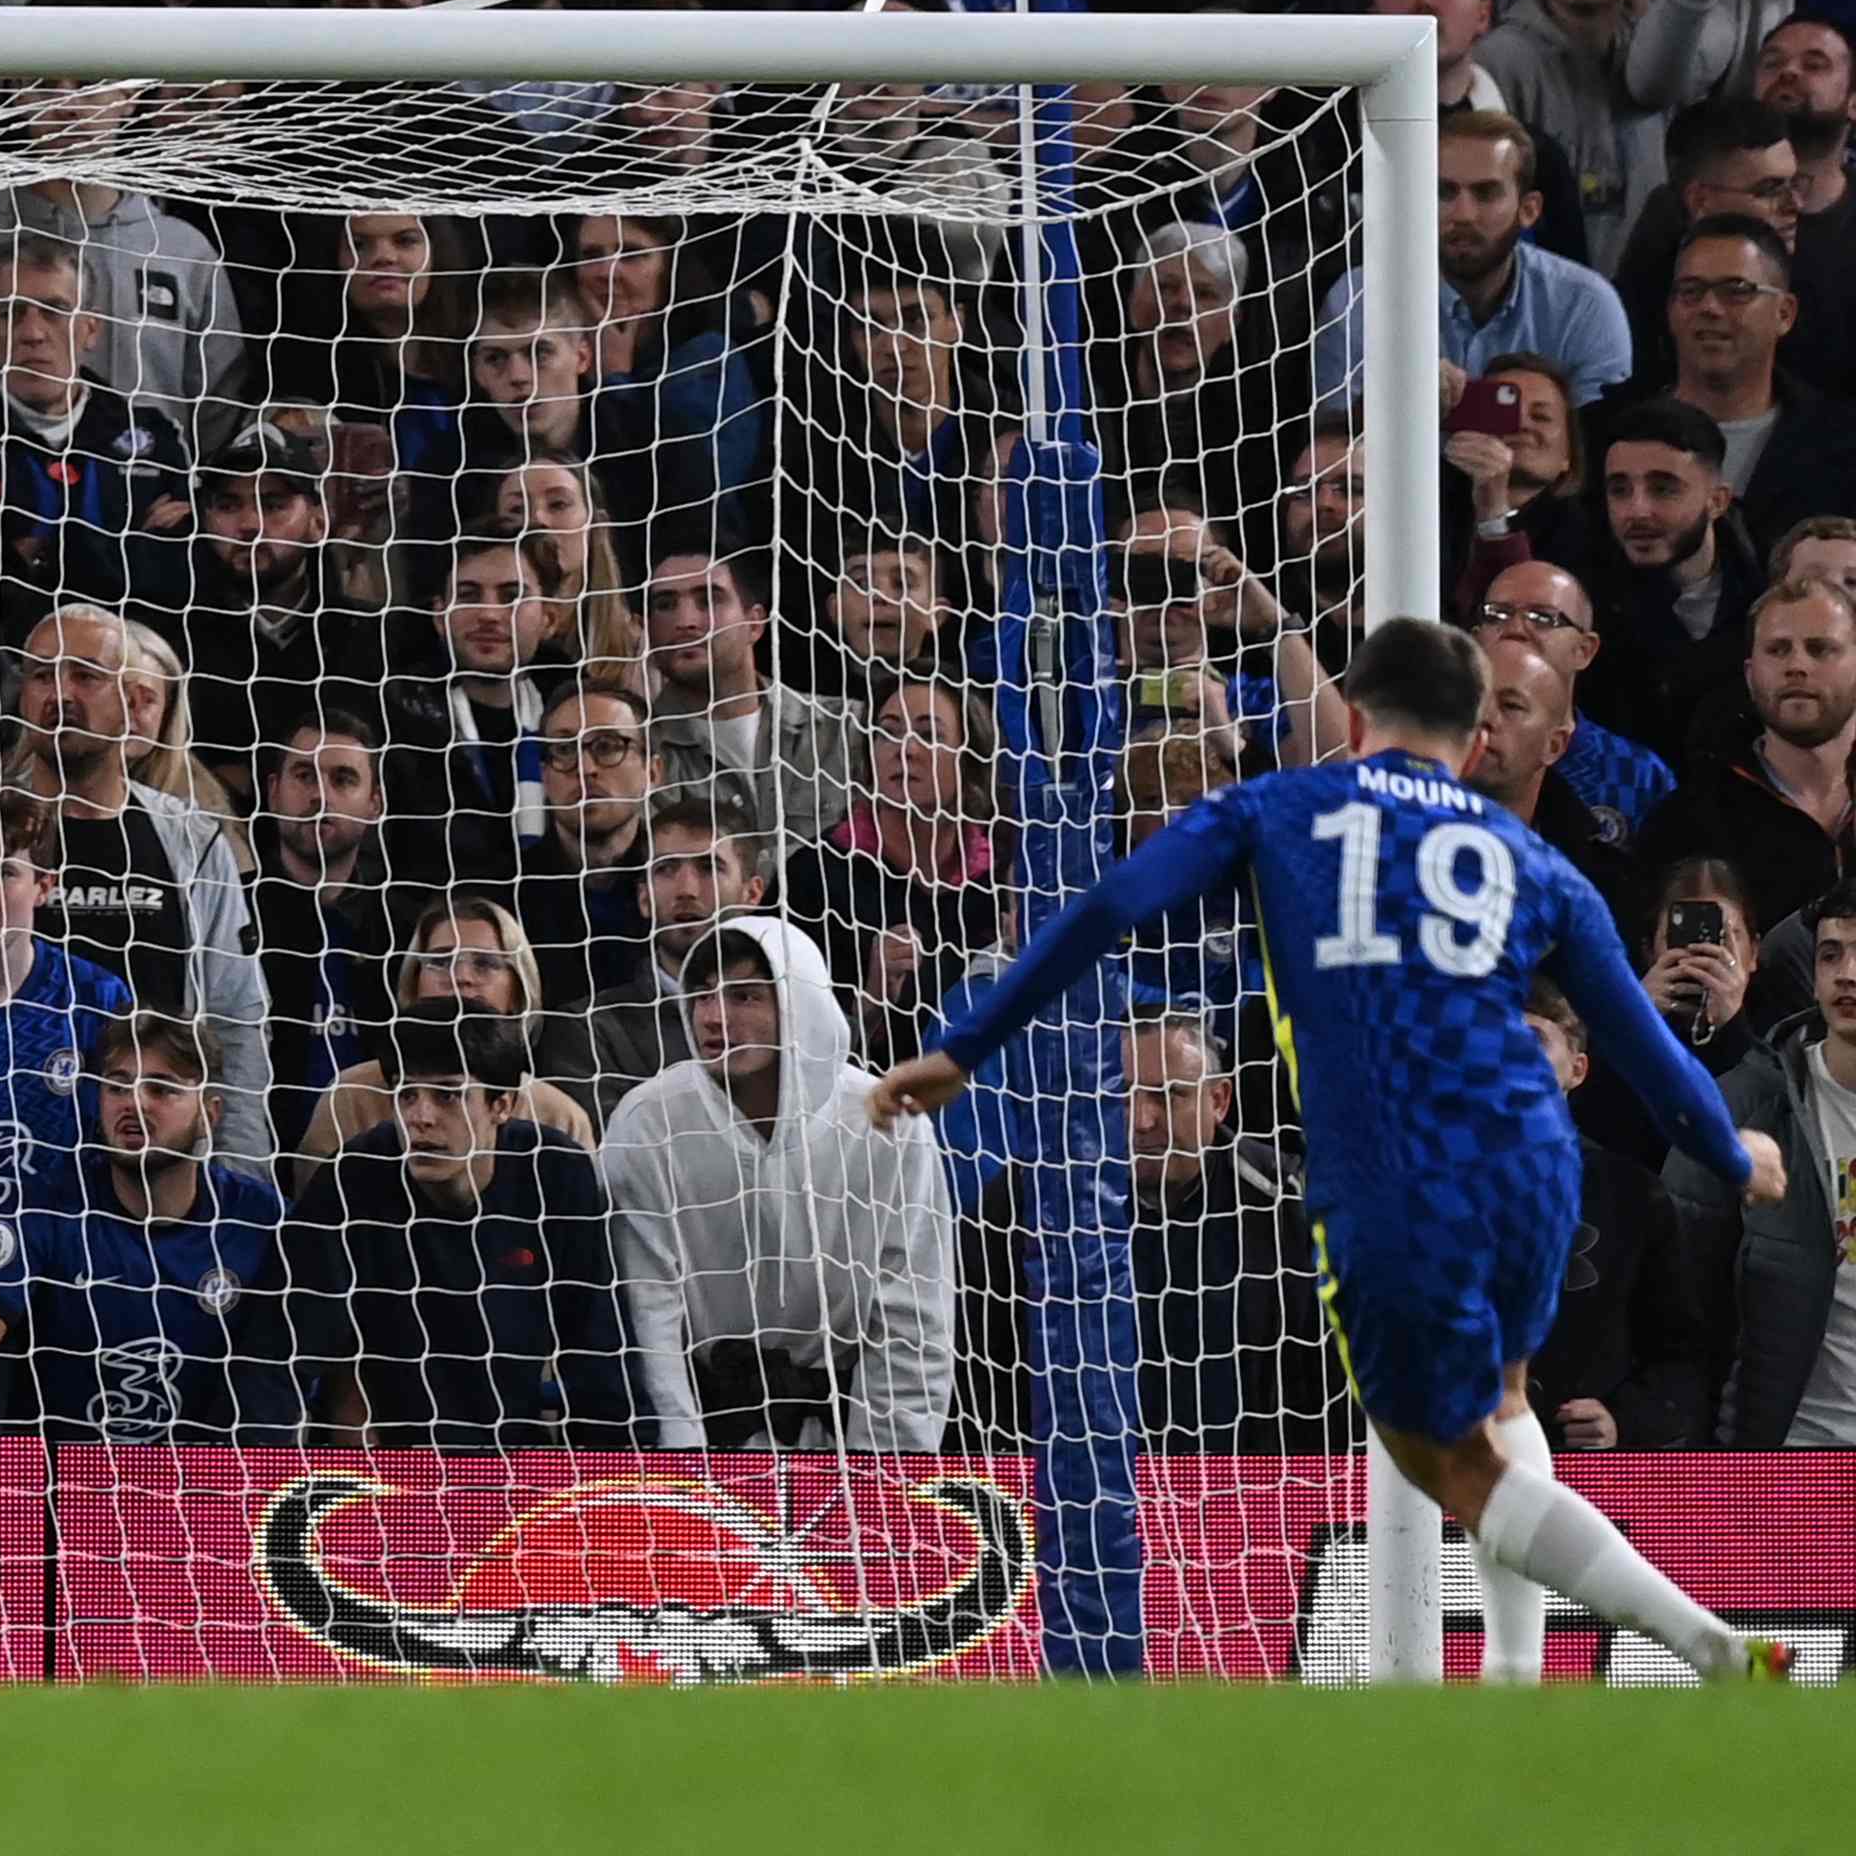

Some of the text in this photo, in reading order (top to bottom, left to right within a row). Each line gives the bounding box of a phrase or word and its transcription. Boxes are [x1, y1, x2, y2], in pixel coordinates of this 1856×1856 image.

[1356, 764, 1484, 816] MOUNT
[46, 885, 165, 909] PARLEZ
[1310, 799, 1518, 979] 19
